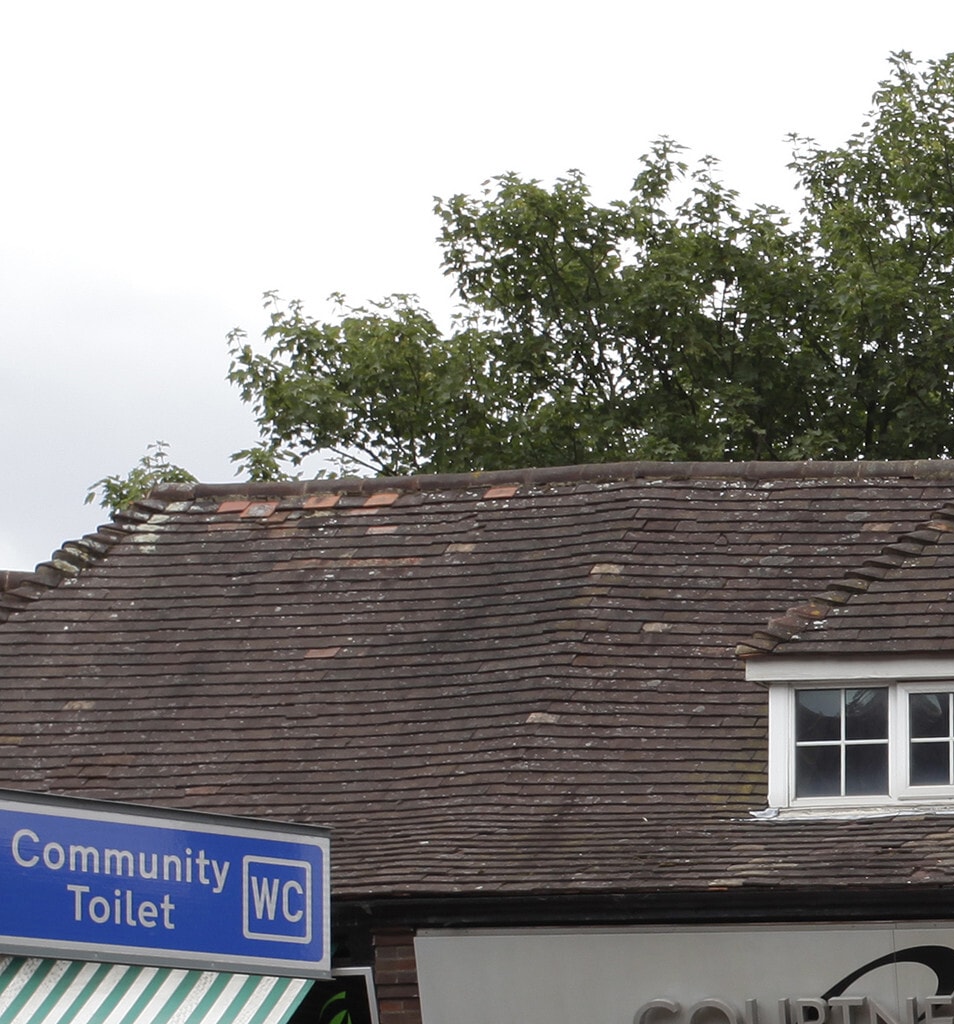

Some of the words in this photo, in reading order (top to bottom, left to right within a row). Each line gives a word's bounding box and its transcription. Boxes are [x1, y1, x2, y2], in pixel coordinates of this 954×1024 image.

[11, 828, 231, 894] Community
[67, 884, 176, 930] Toilet
[250, 875, 304, 923] WC
